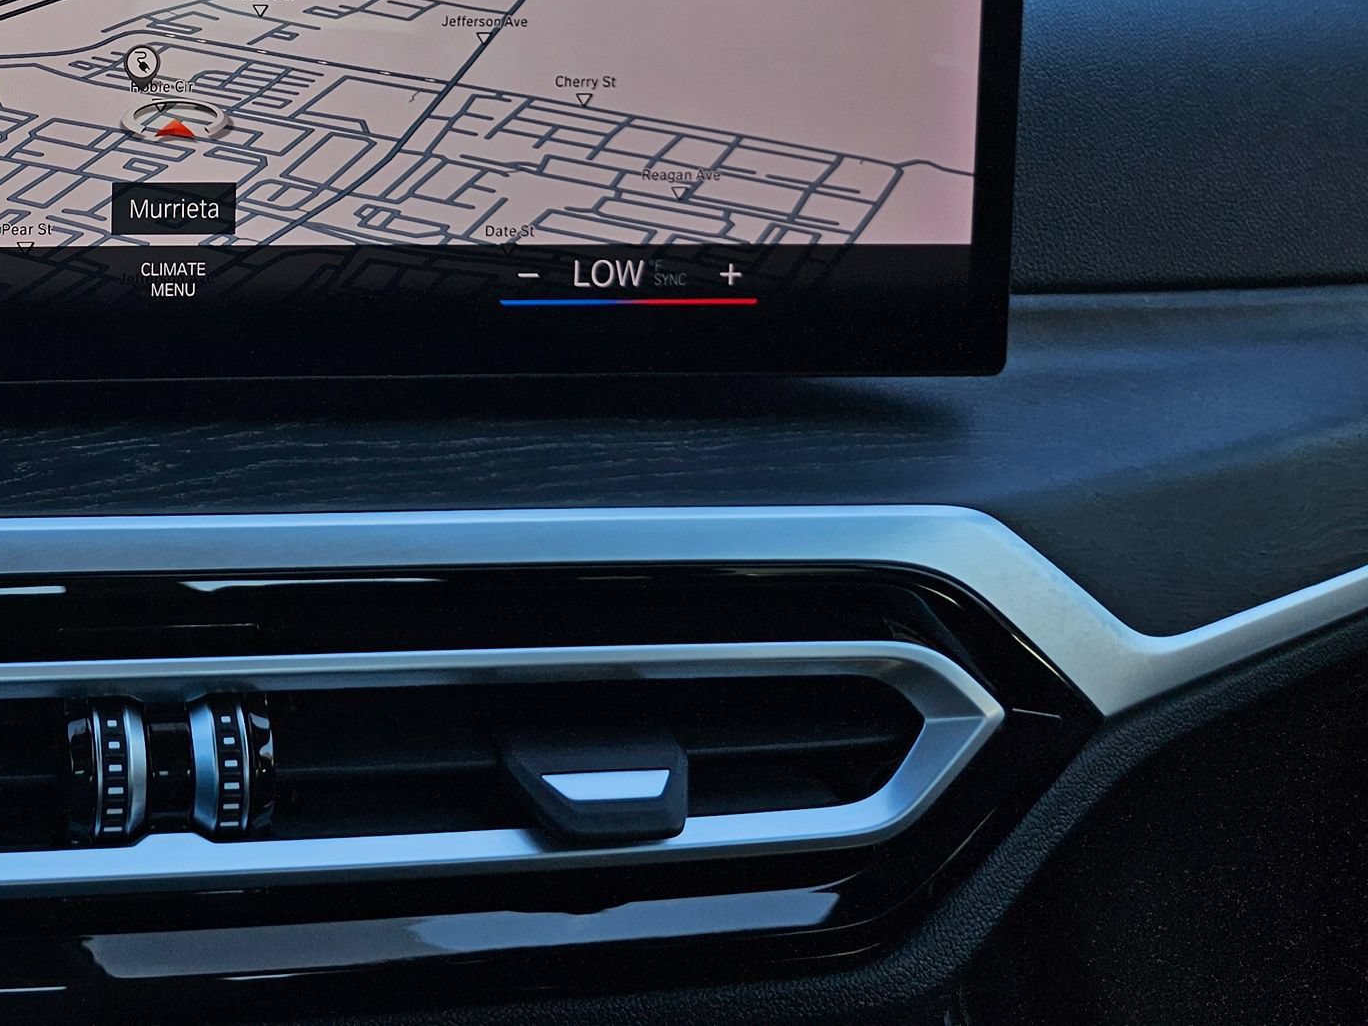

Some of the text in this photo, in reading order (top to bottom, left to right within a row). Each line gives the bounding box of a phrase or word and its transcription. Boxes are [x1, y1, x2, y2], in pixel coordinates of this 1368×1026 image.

[441, 16, 528, 28] Jefferson Ave
[175, 80, 194, 92] Cir
[555, 75, 616, 91] Cherry St
[642, 169, 721, 184] Reagan Ave
[129, 199, 220, 219] Murrieta
[2, 222, 53, 236] Pear St
[485, 225, 535, 238] Date St
[140, 262, 206, 277] CLIMATE
[574, 259, 645, 287] LOW
[654, 272, 687, 286] SYNC
[151, 283, 196, 297] MENU
